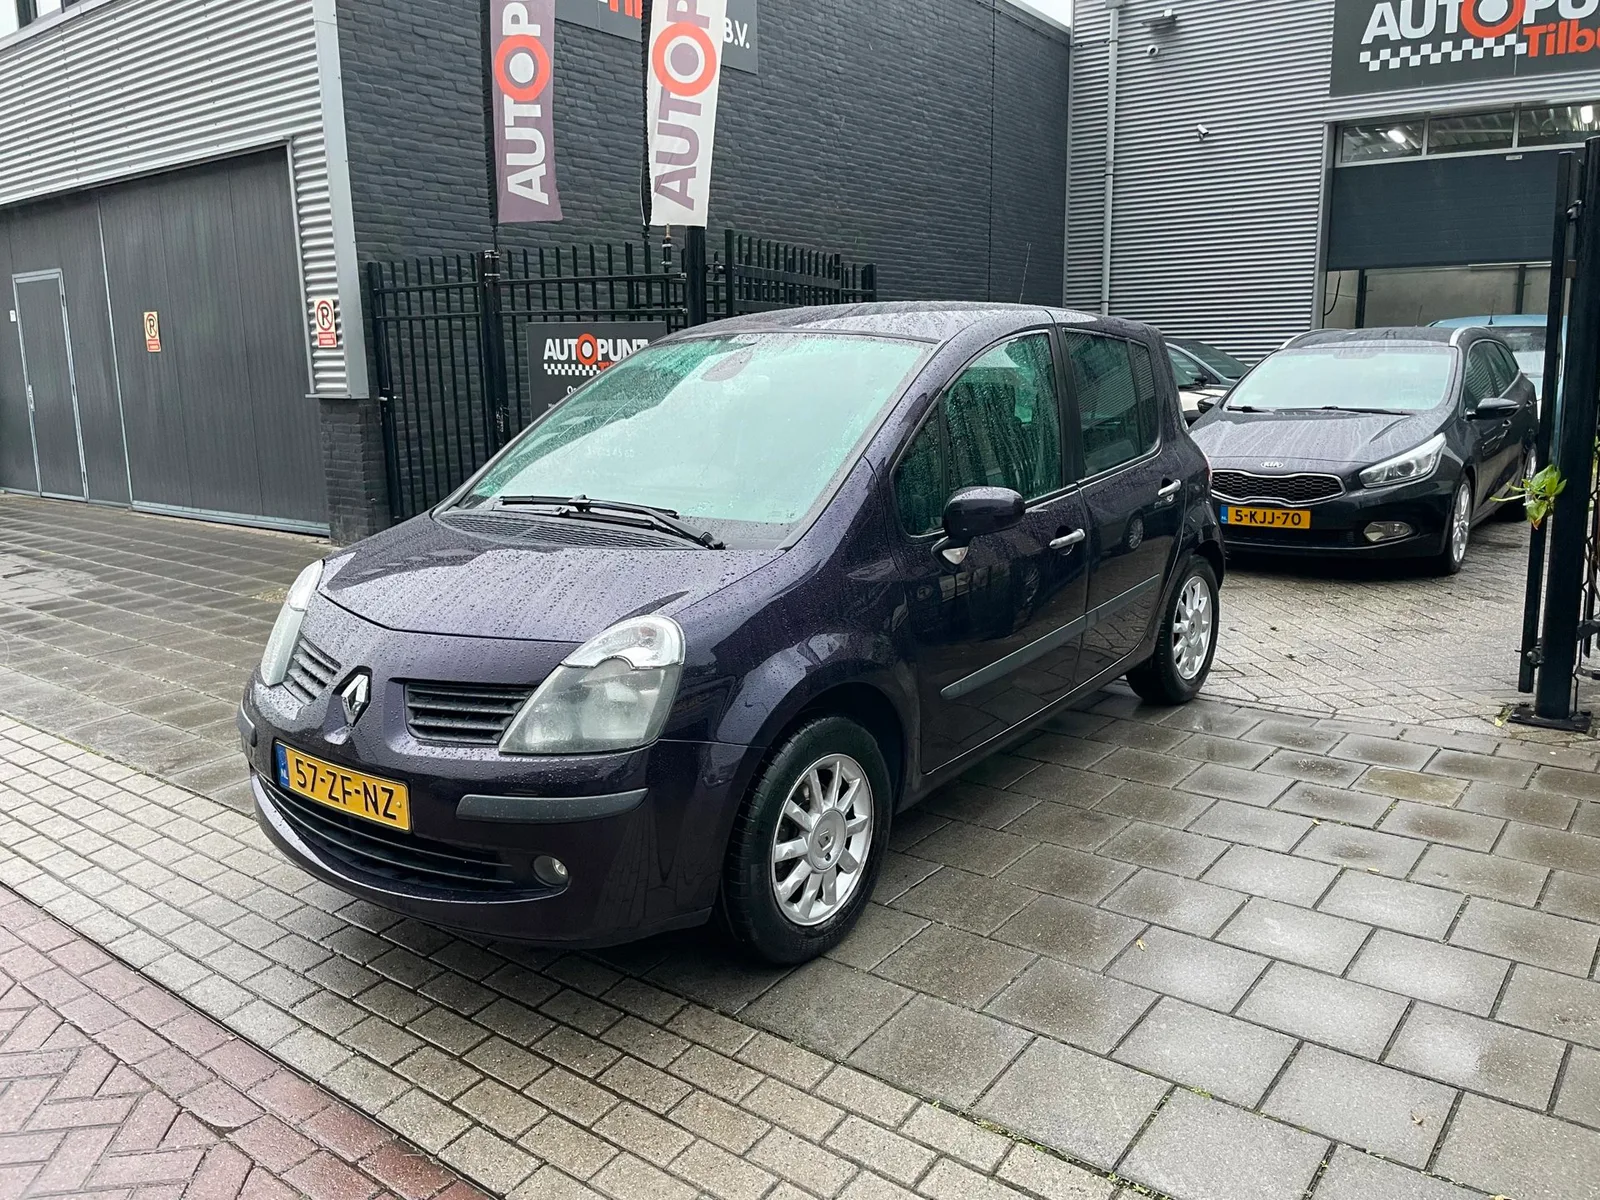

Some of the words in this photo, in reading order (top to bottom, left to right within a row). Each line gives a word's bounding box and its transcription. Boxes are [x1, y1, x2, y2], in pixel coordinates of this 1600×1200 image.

[1523, 19, 1600, 58] Tilb
[1235, 509, 1302, 526] 5-KJJ-70
[295, 758, 397, 820] 57-ZF-NZ
